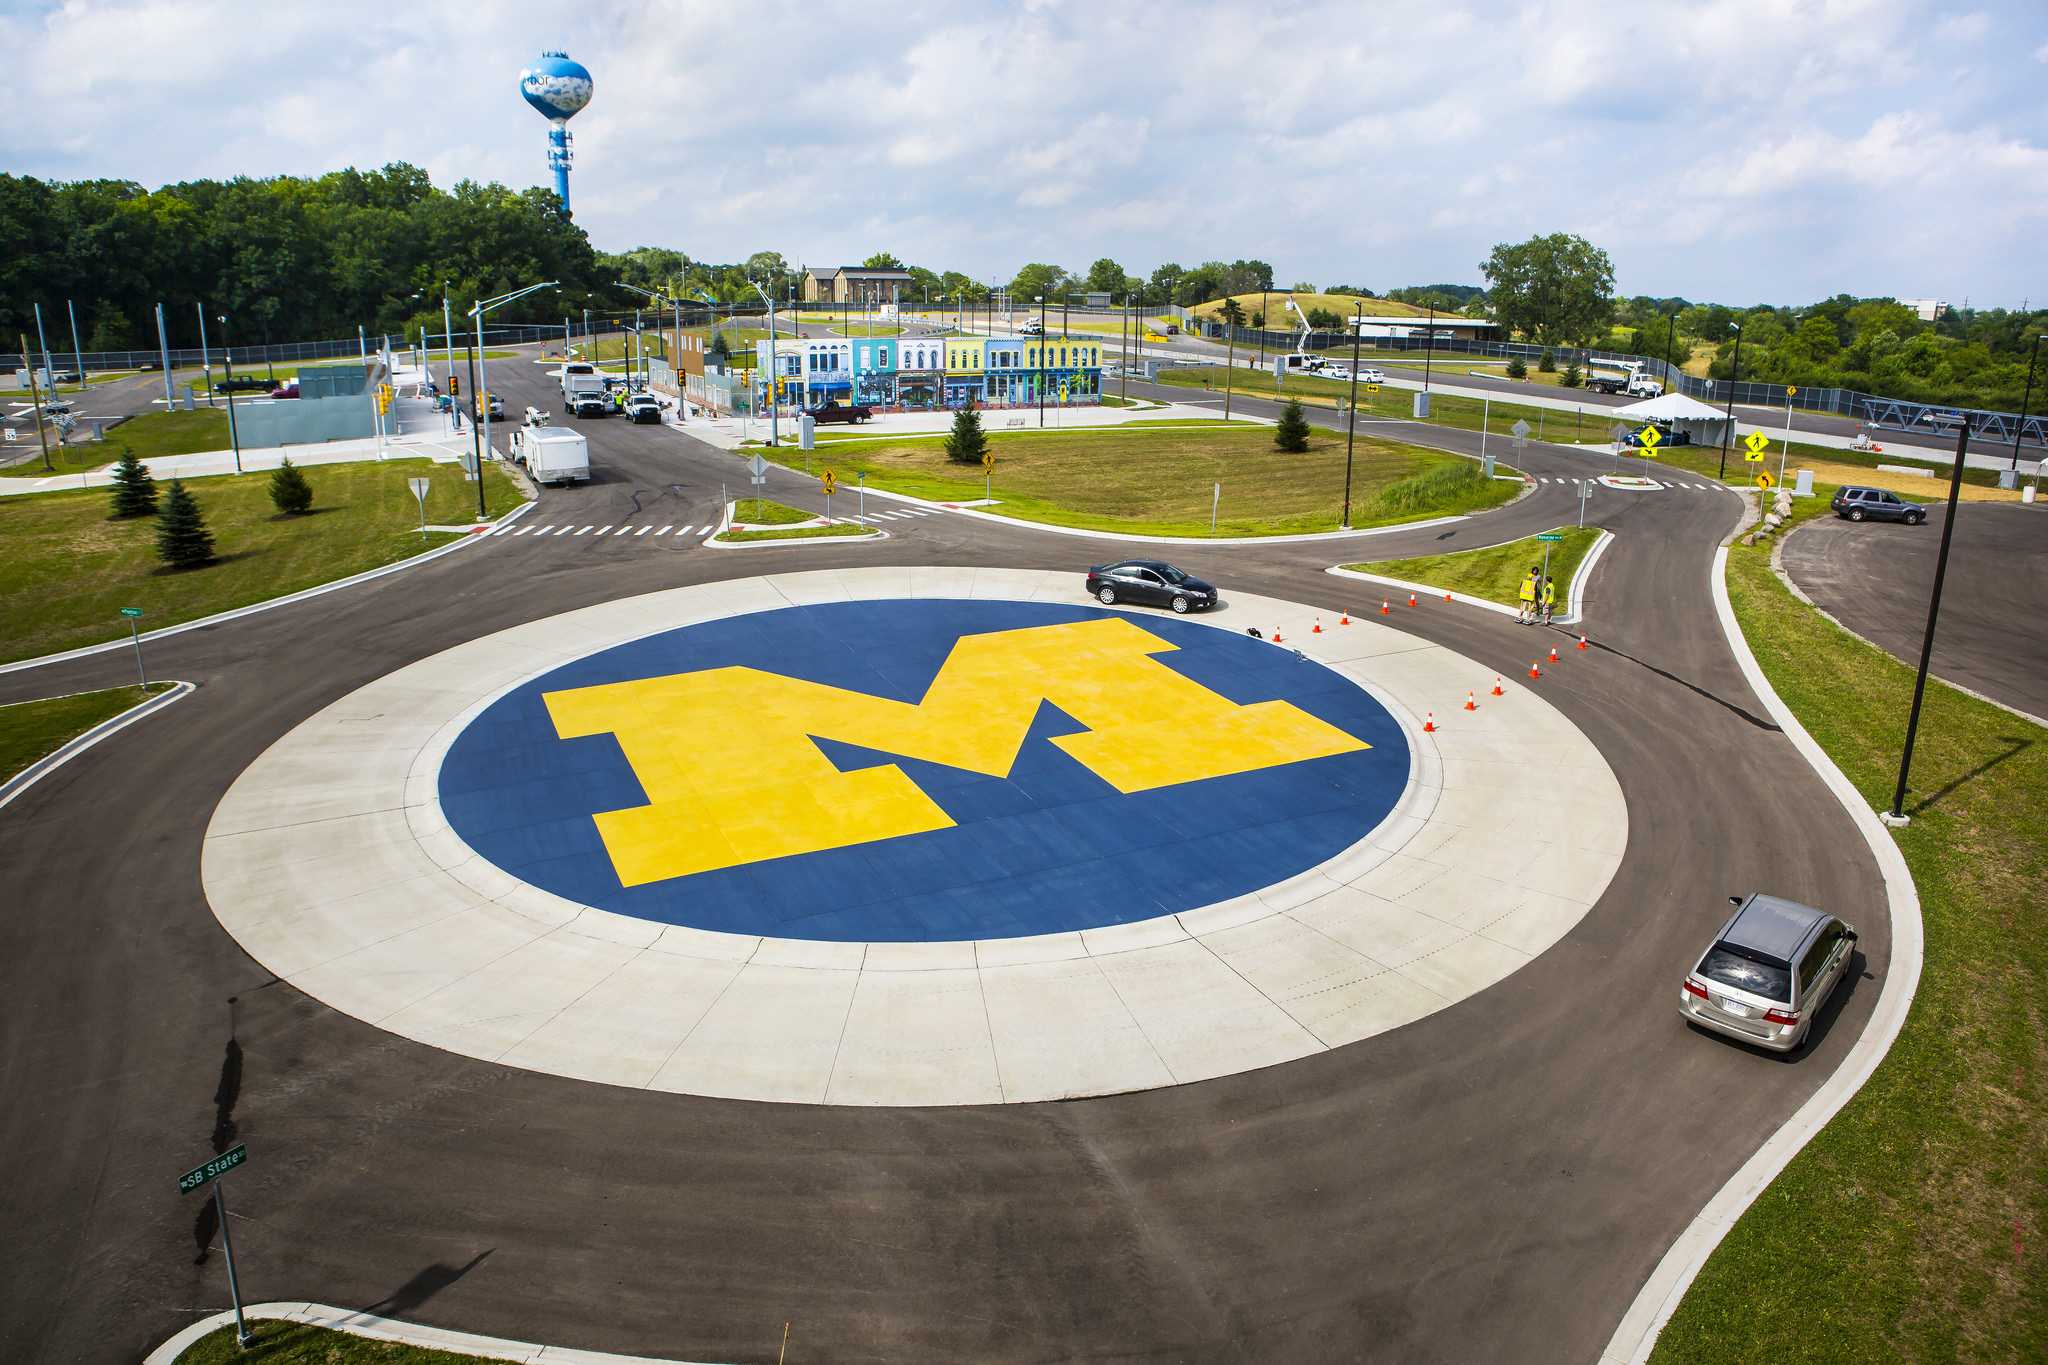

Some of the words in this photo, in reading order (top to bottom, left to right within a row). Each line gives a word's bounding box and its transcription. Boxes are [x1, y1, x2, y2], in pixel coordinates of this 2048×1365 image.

[542, 617, 1373, 888] M
[187, 1171, 203, 1187] SB
[207, 1153, 239, 1176] State
